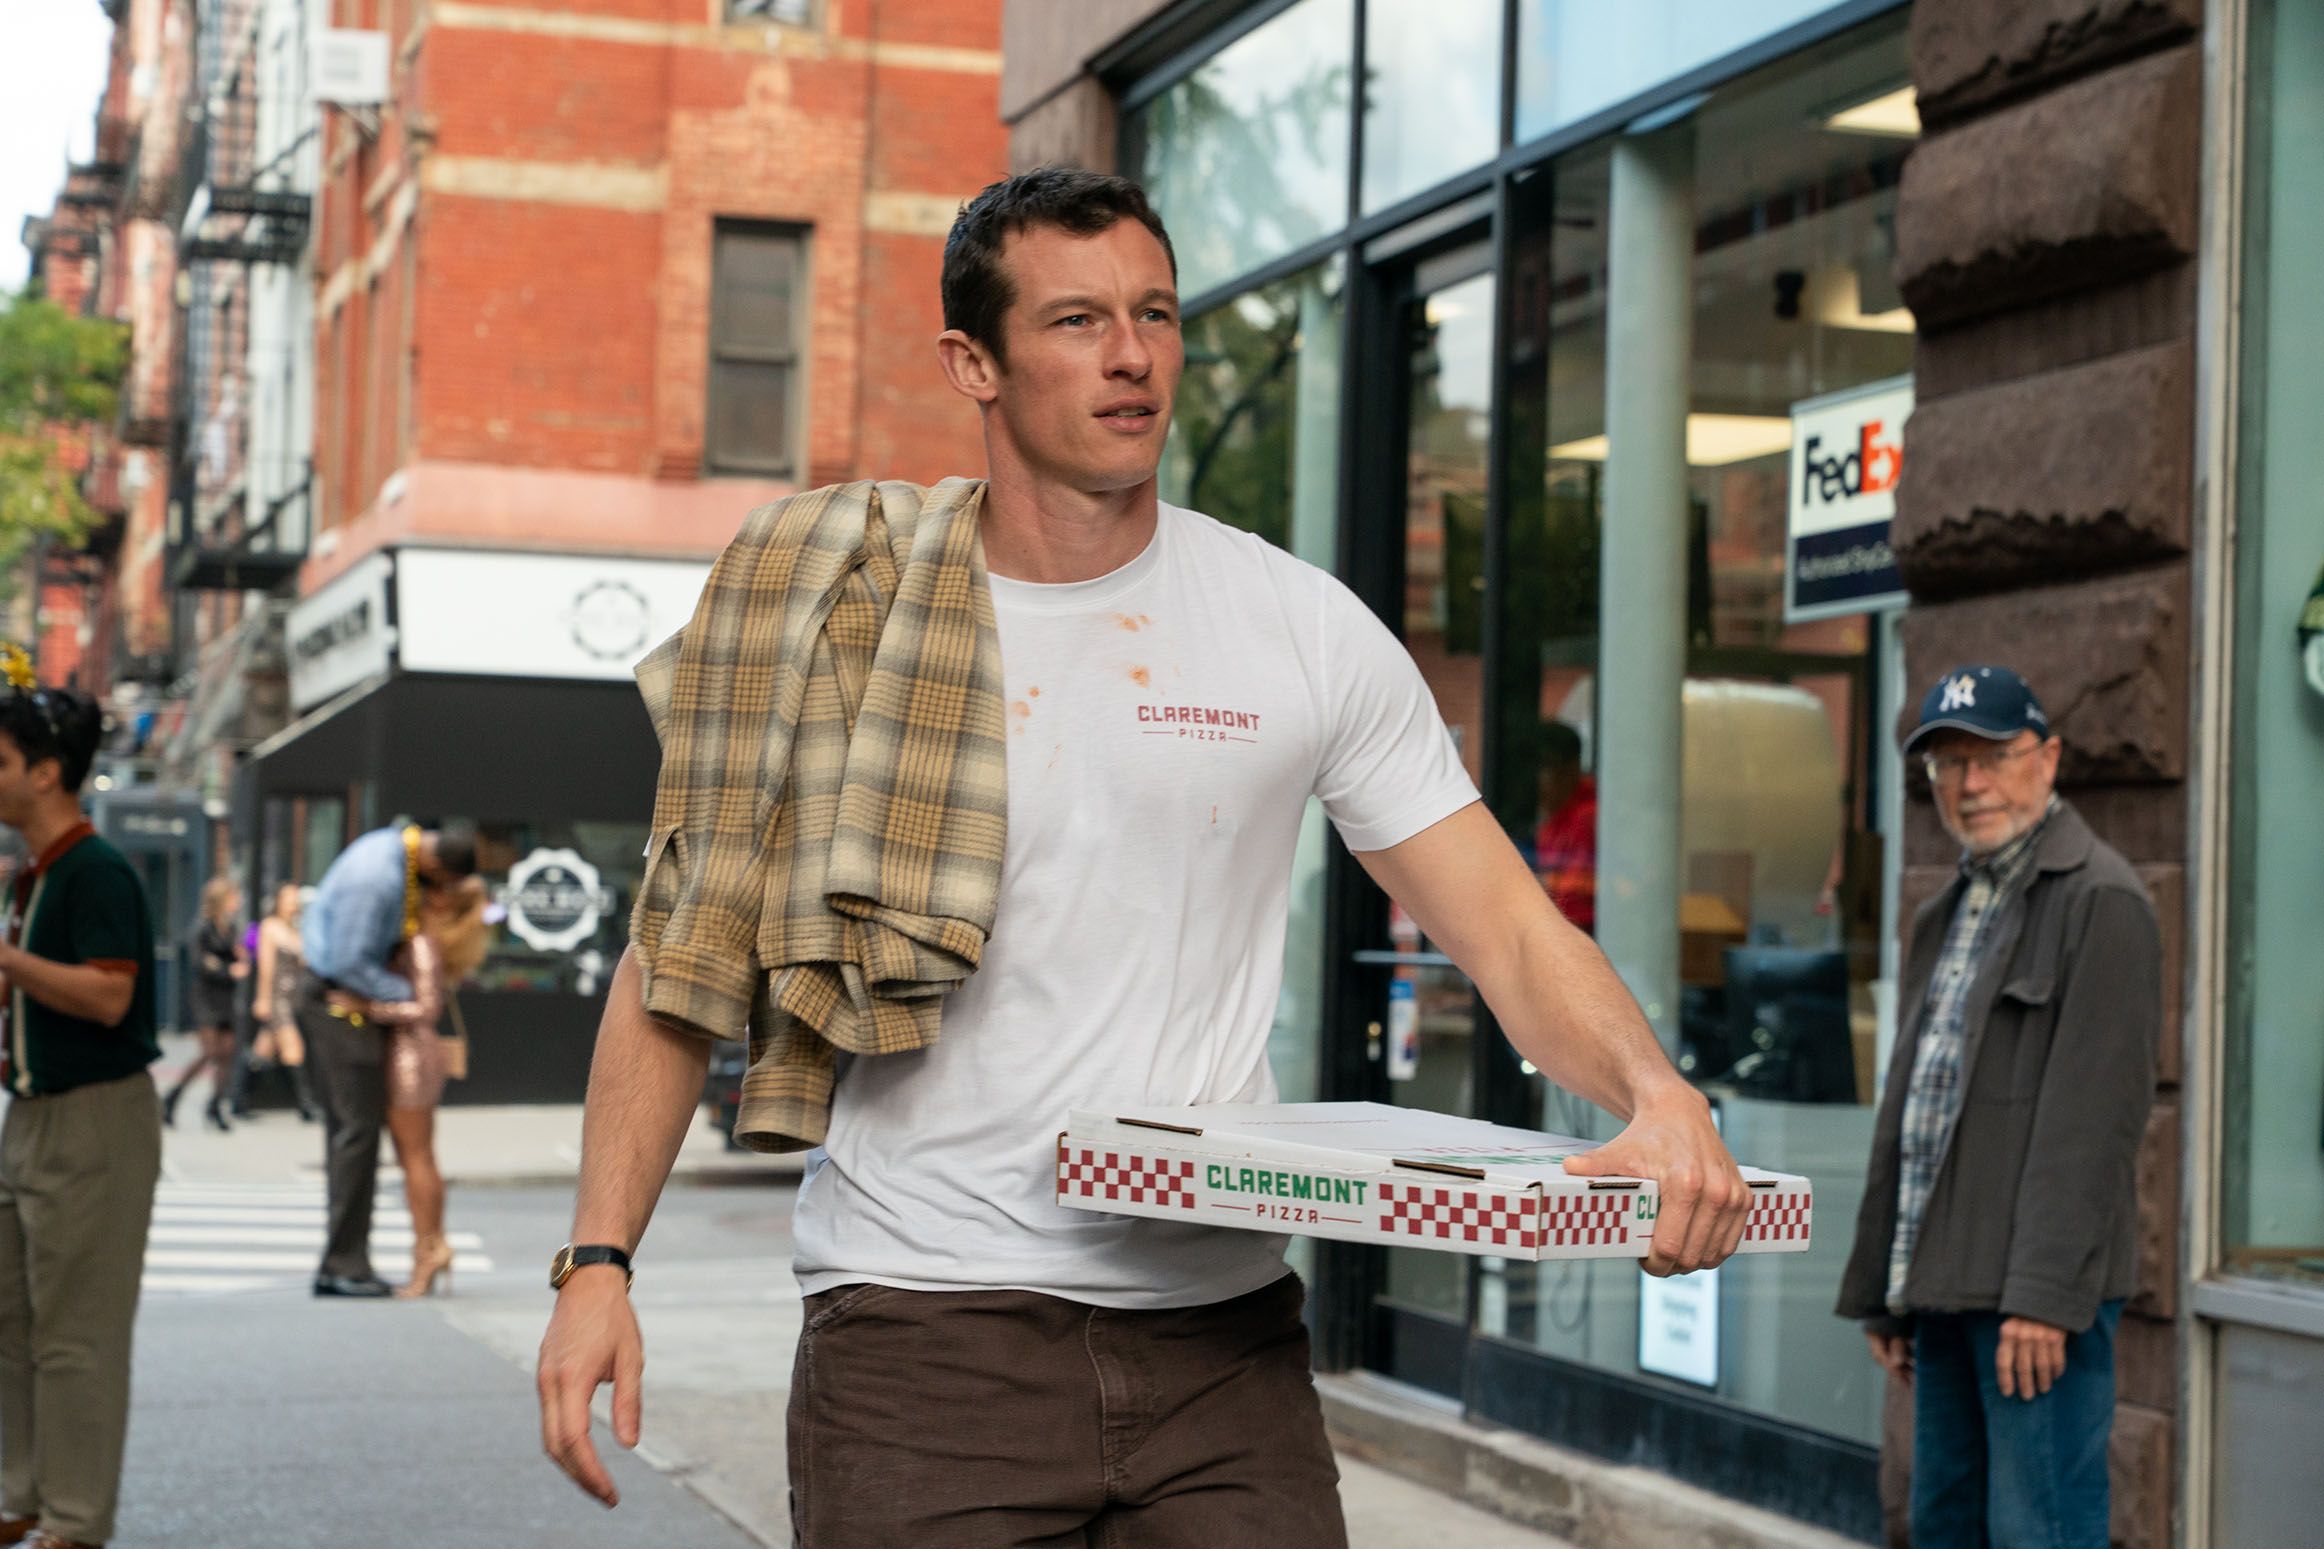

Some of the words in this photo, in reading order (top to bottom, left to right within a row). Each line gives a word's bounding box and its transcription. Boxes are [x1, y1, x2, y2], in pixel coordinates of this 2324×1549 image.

[1138, 705, 1260, 731] CLAREMONT
[1179, 728, 1226, 741] PIZZA
[1207, 1164, 1368, 1206] CLAREMONT
[1257, 1203, 1319, 1224] PIZZA
[1637, 1195, 1660, 1219] CL
